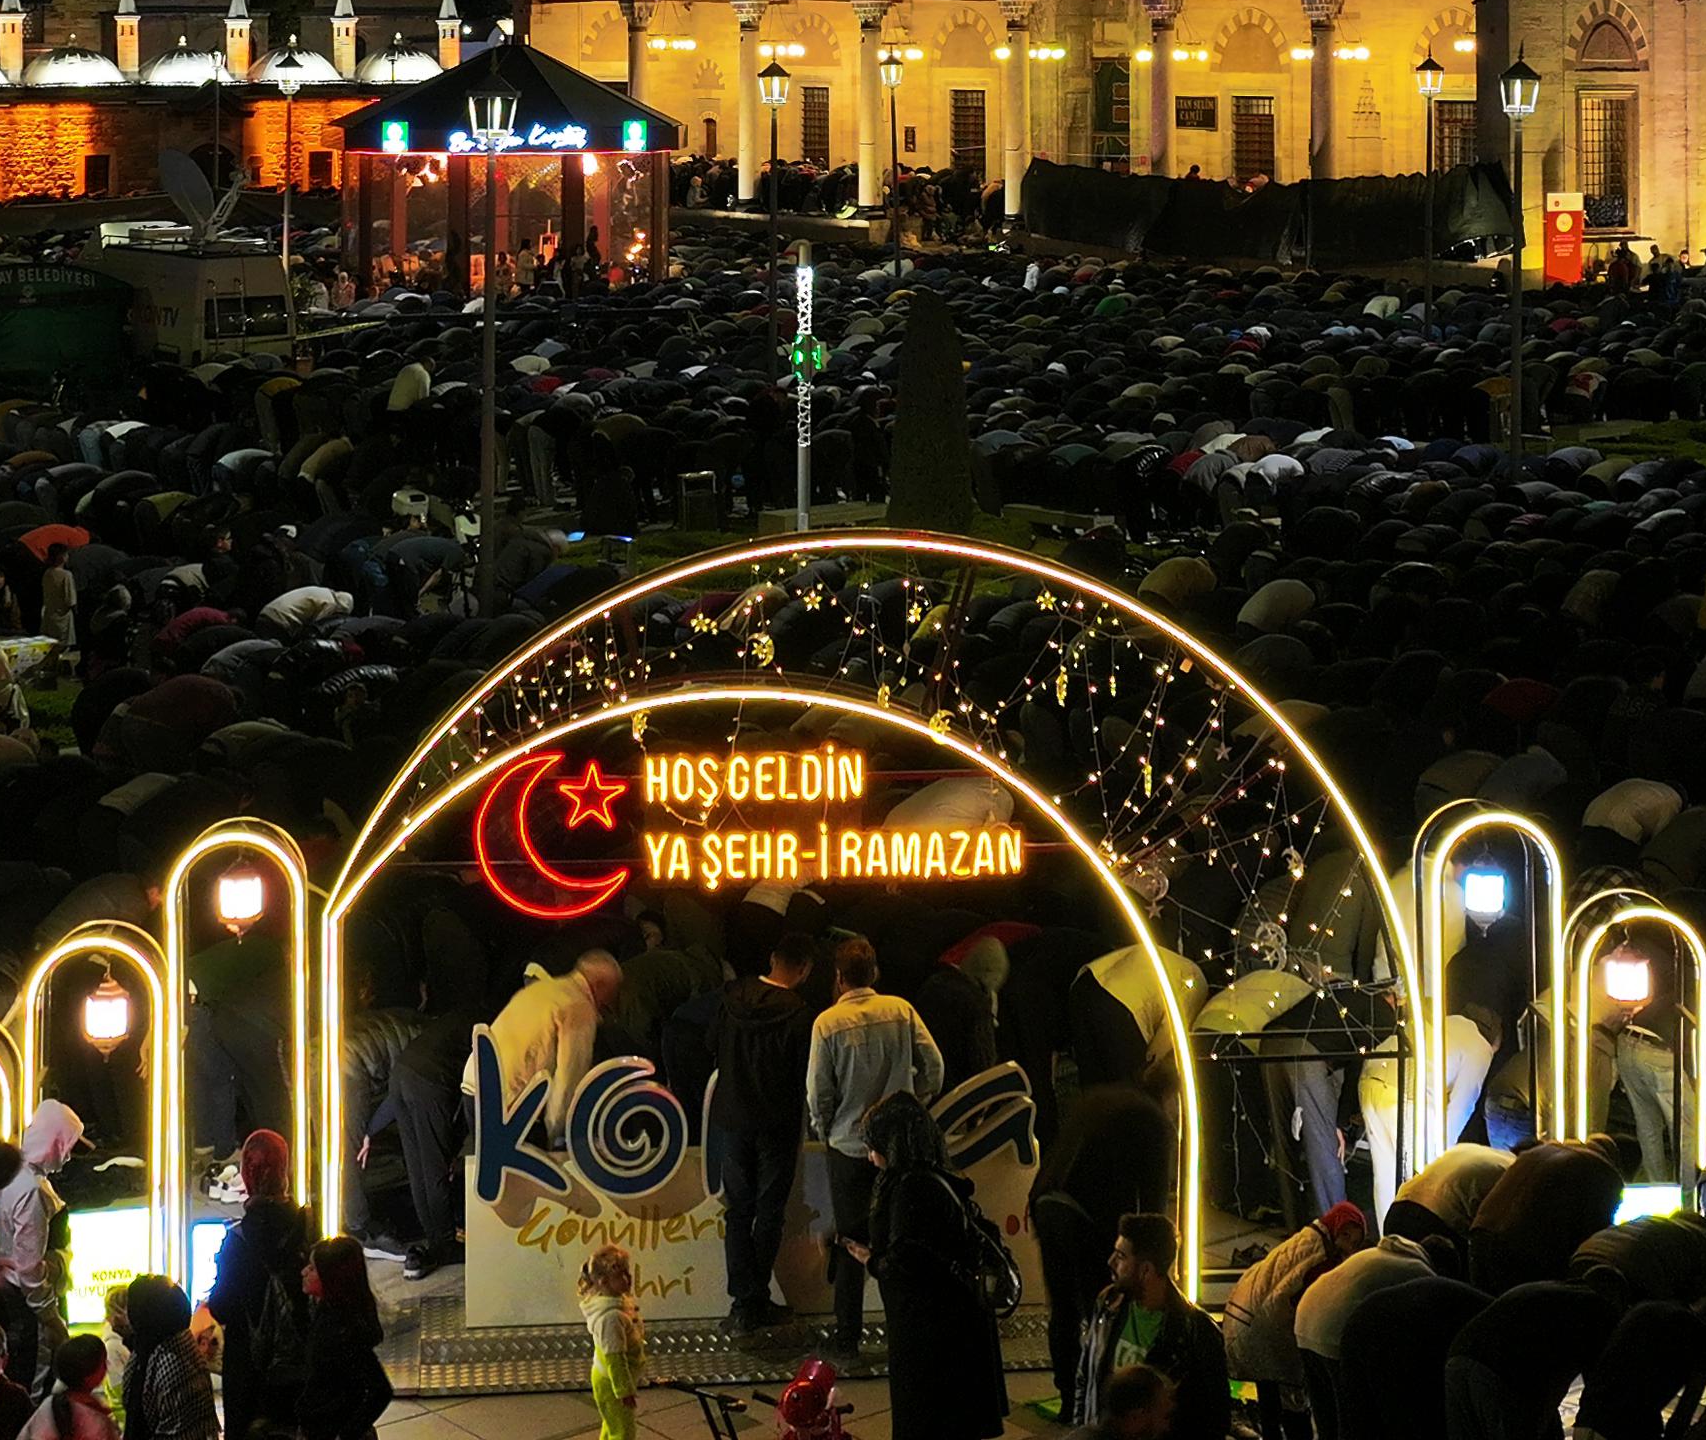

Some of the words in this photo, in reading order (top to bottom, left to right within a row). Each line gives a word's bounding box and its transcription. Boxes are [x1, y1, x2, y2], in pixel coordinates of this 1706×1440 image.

[644, 831, 692, 880] YA
[699, 821, 829, 891] ŞEHR-İ
[840, 829, 1024, 880] RAMAZAN
[91, 1269, 132, 1282] KONYA
